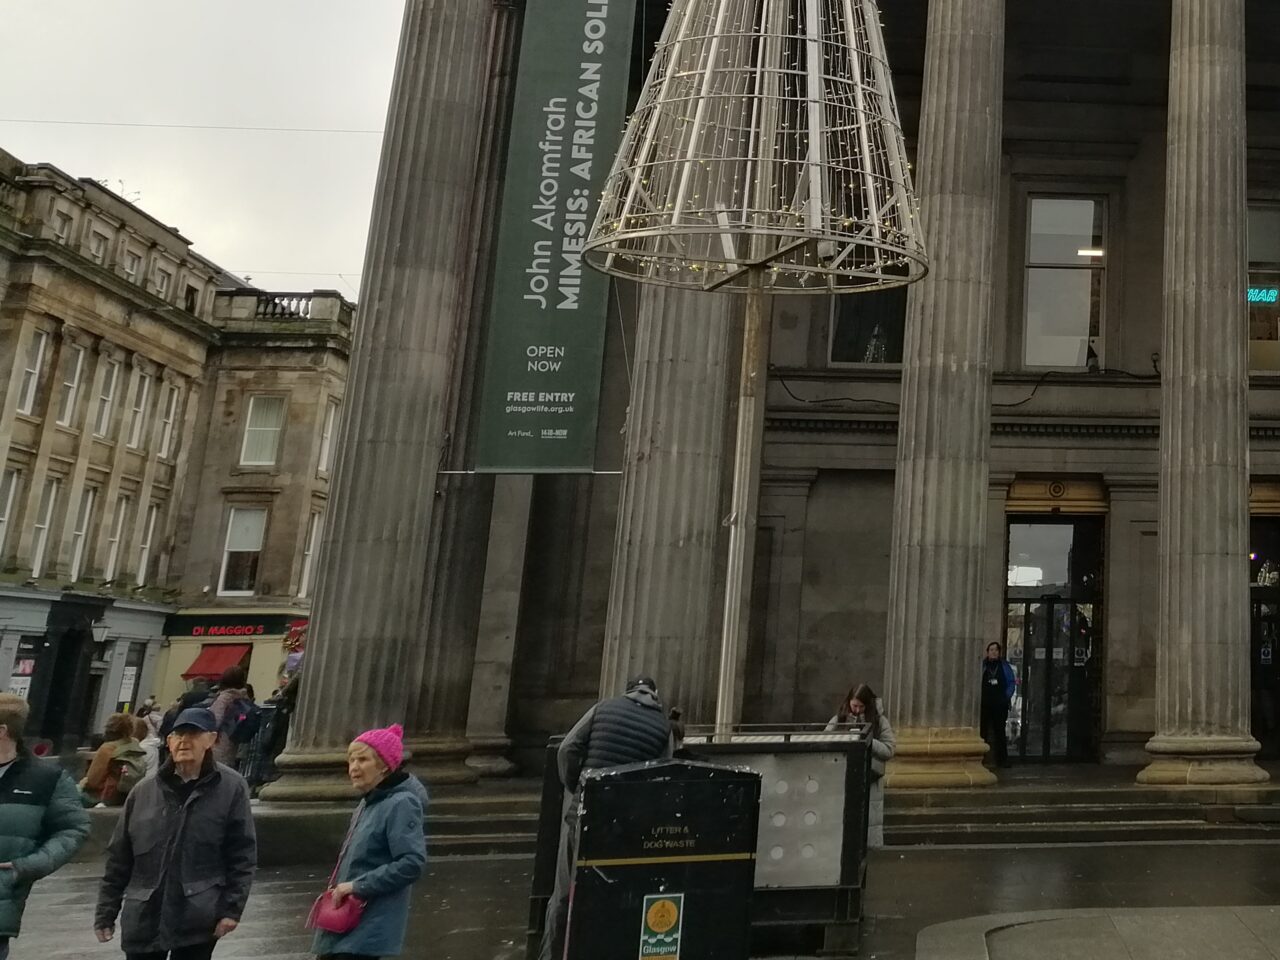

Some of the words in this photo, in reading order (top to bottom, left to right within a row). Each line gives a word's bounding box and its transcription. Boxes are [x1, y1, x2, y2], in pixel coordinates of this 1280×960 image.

[570, 63, 602, 181] AFRICAN
[531, 97, 568, 231] Akomfrah
[556, 188, 589, 310] MIMESIS:
[523, 240, 552, 310] John
[526, 345, 565, 358] OPEN
[527, 361, 561, 373] NOW
[507, 392, 536, 402] FREE
[538, 392, 576, 402] ENTRY
[505, 405, 574, 414] glasgowlife.org.uk
[192, 625, 204, 636] DI
[651, 826, 682, 835] LITTER
[643, 840, 663, 849] DOG
[664, 839, 696, 849] WASTE
[642, 944, 678, 955] Glasgow
